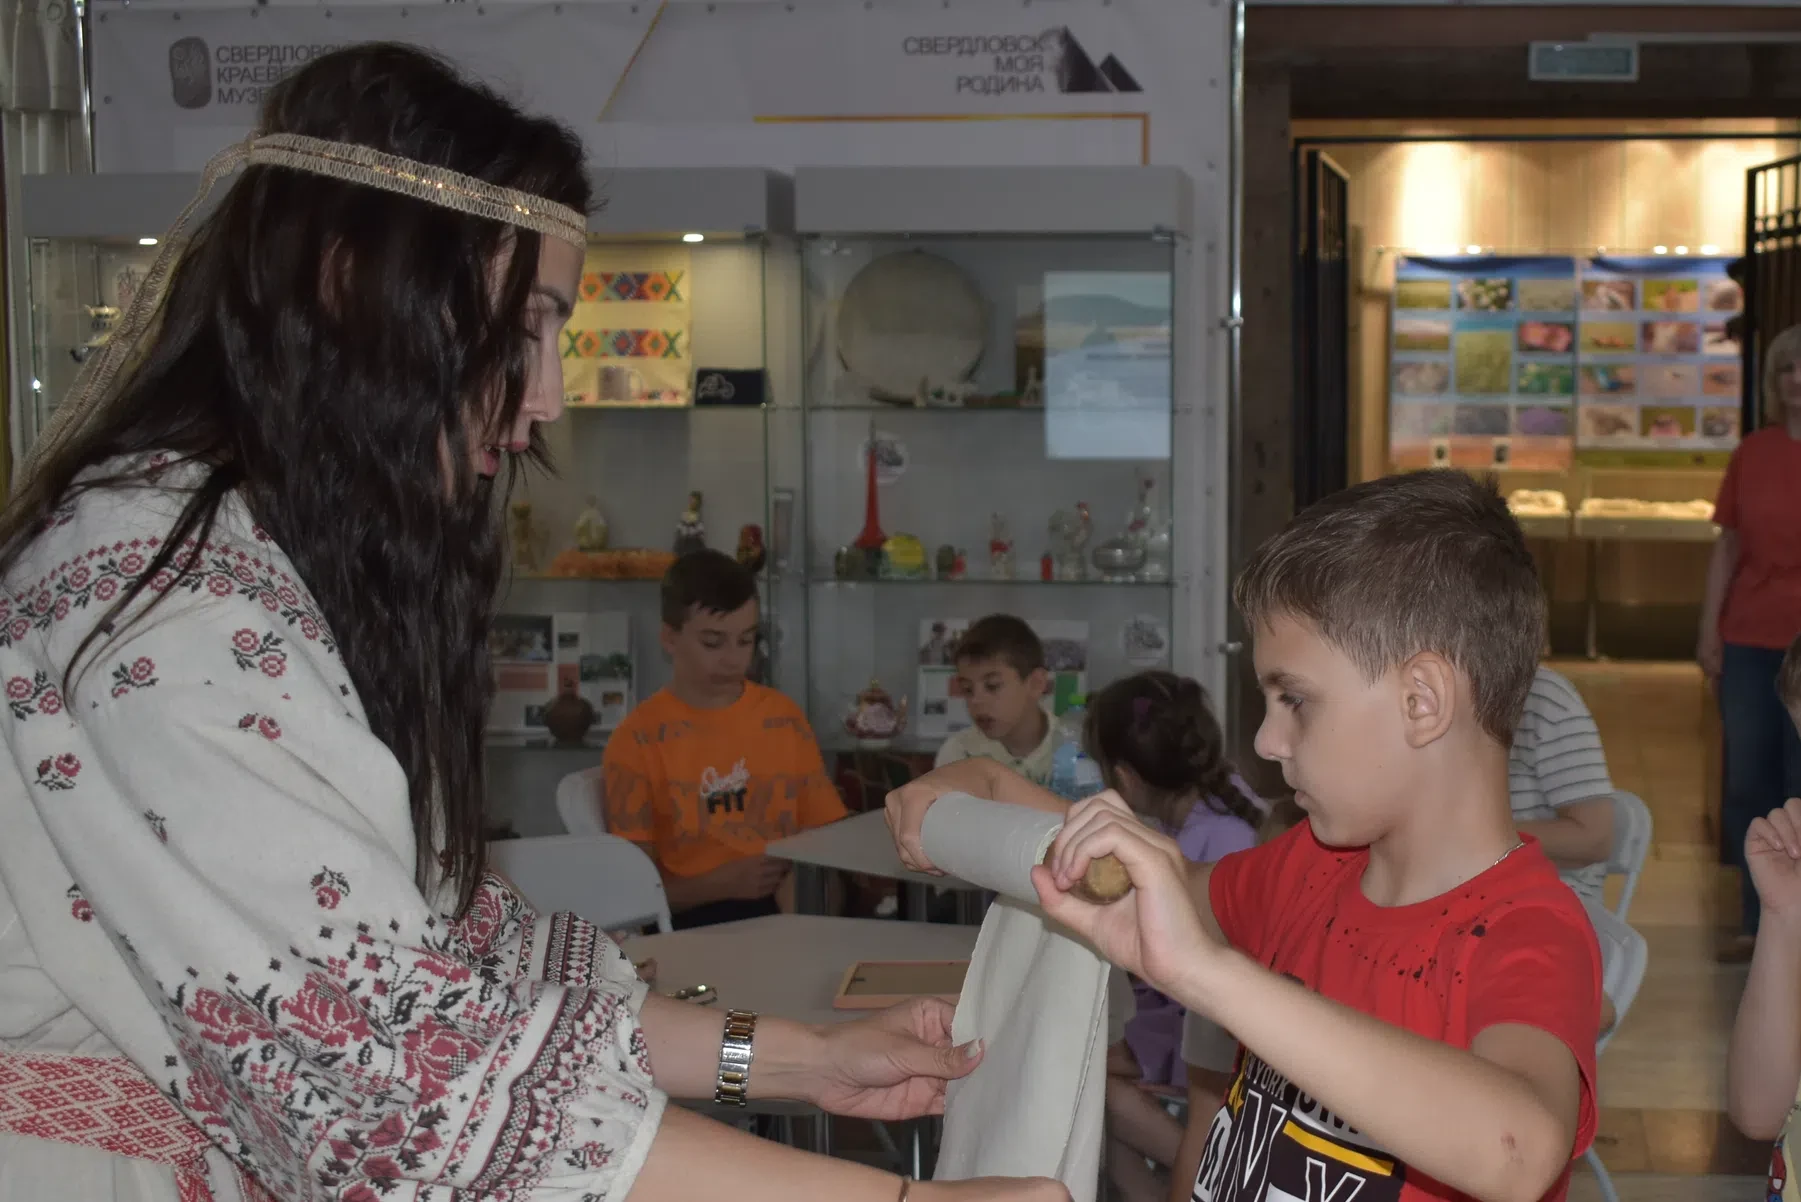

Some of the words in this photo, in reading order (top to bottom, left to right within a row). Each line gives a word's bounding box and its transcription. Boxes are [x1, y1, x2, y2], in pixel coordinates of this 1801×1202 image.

[216, 43, 345, 65] СВЕРДЛОВС
[903, 36, 1045, 56] СВЕРДЛОВСК
[995, 56, 1043, 73] МОЯ
[956, 74, 1045, 96] РОДИНА
[707, 788, 748, 814] FIT
[1253, 1059, 1292, 1101] YORK
